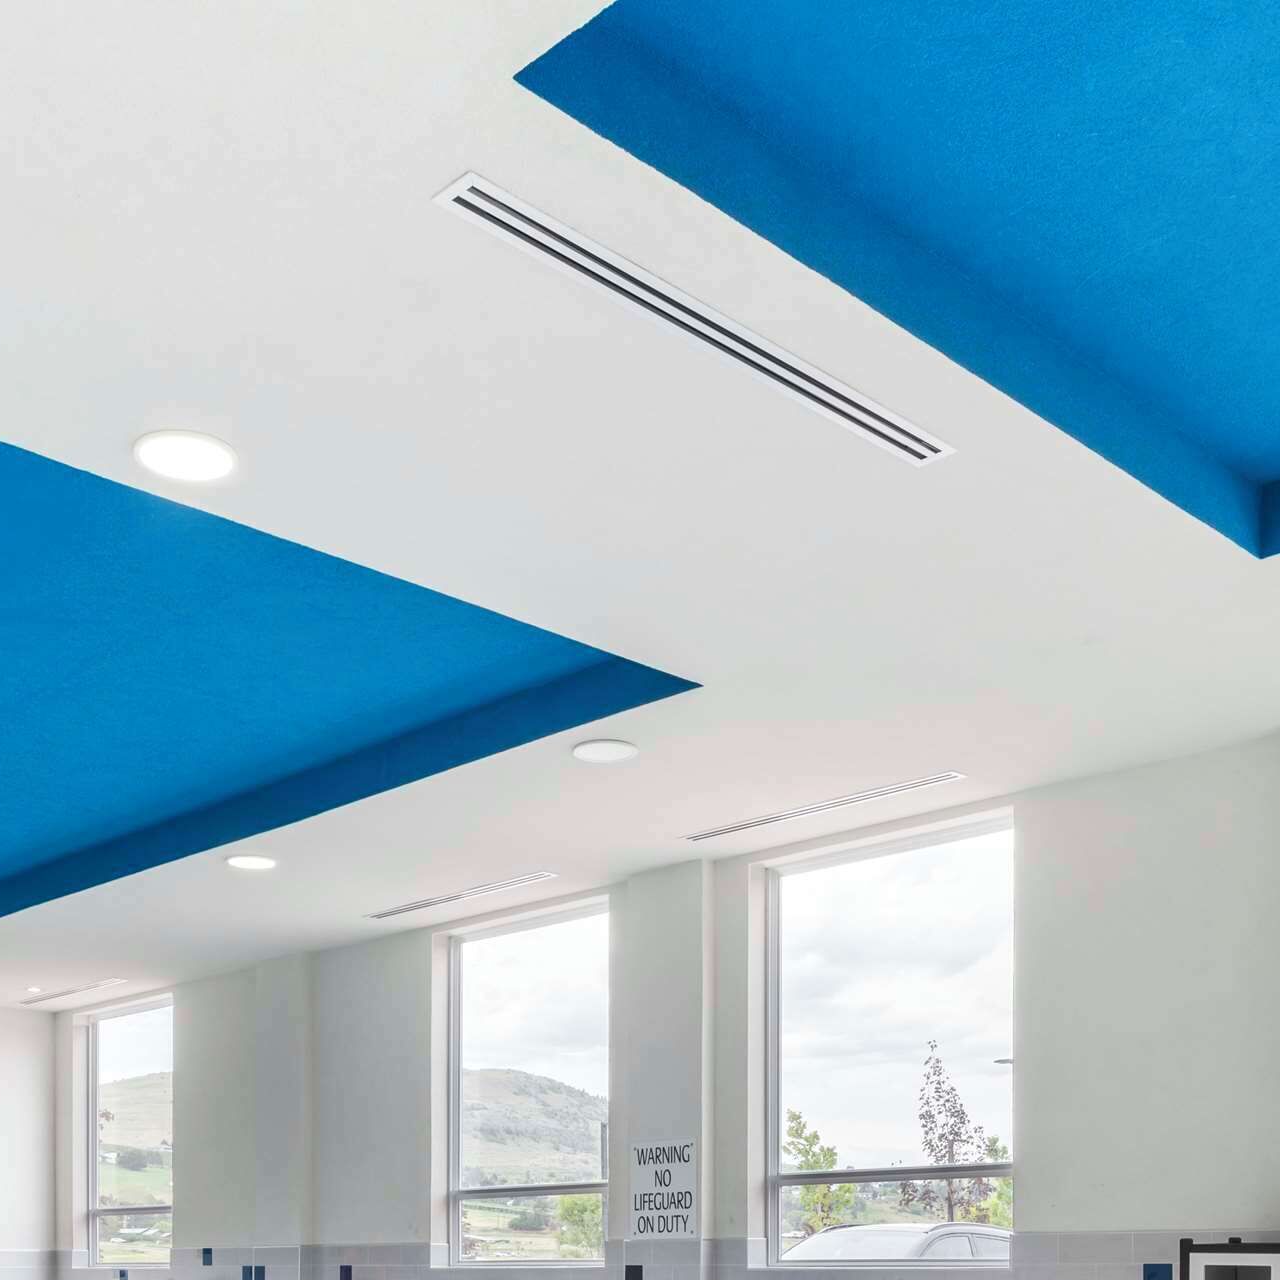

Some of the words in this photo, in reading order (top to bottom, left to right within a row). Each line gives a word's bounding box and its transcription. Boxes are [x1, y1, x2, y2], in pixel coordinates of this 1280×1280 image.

[637, 1144, 690, 1165] WARNING
[654, 1169, 672, 1187] NO
[634, 1191, 693, 1211] LIFEGUARD
[637, 1215, 654, 1233] ON
[658, 1215, 688, 1233] DUTY
